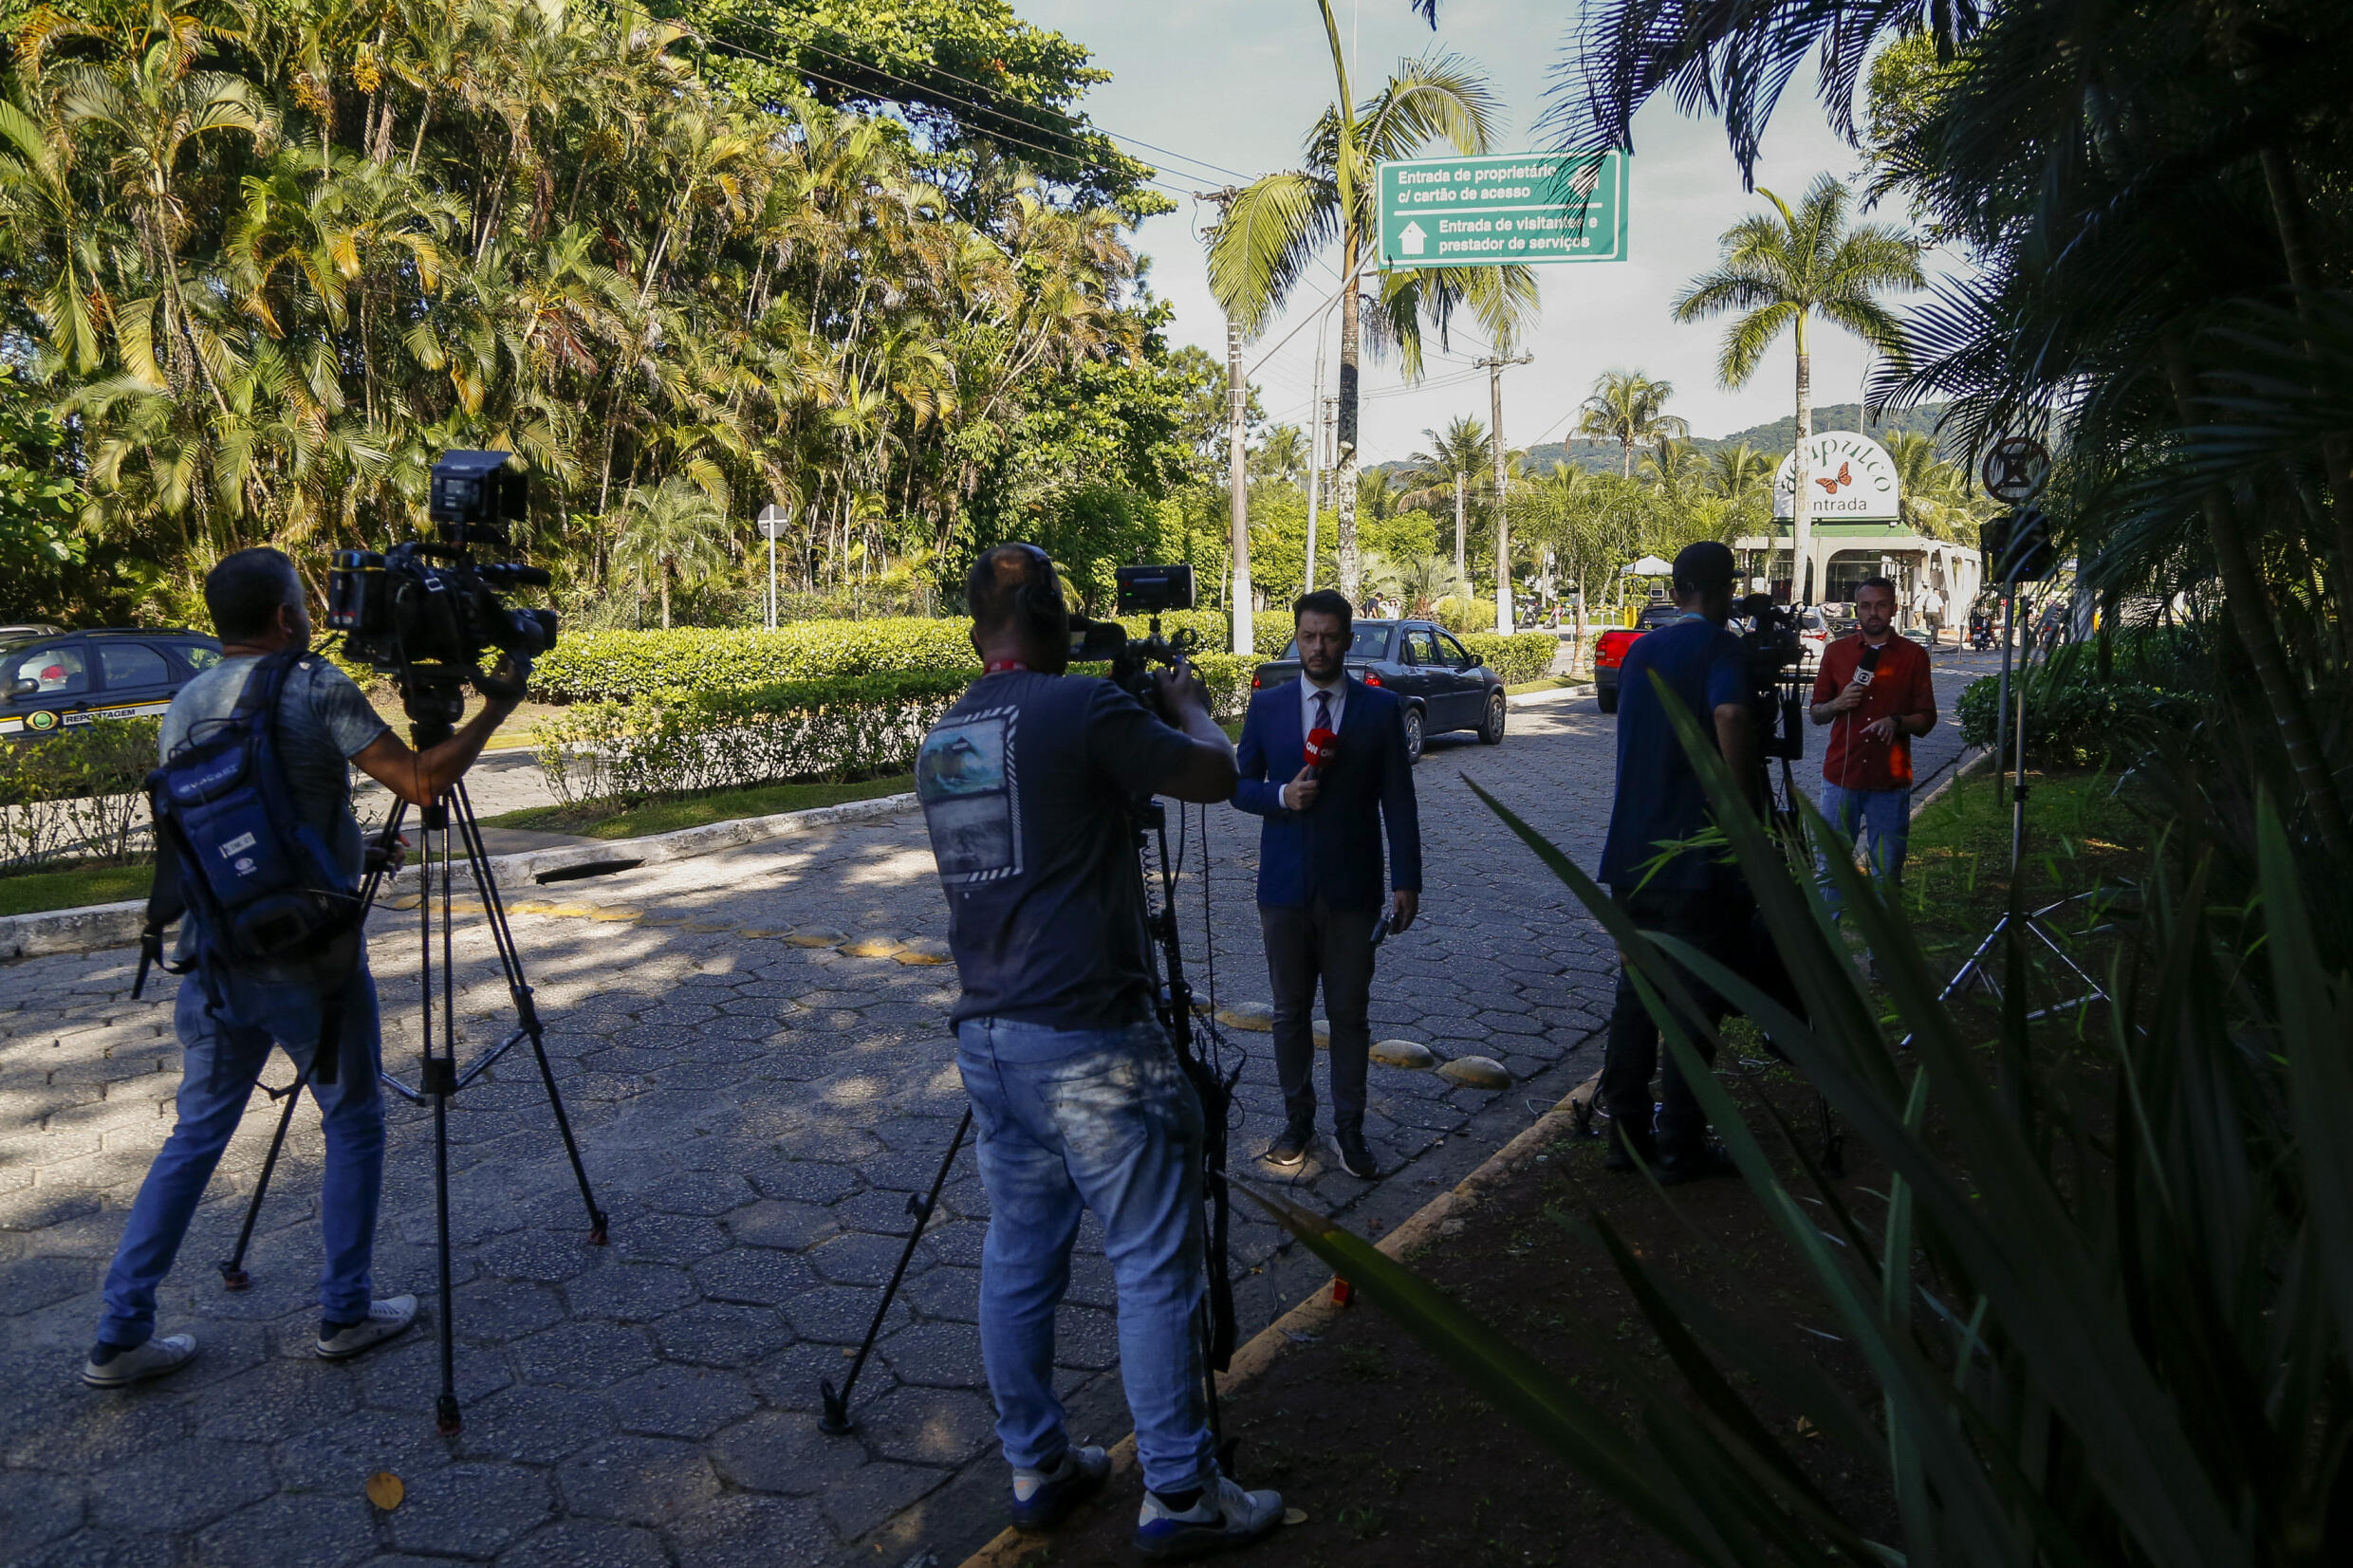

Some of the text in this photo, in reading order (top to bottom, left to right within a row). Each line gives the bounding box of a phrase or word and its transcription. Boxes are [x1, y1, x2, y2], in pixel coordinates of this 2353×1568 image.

[1398, 169, 1451, 185] Entrada
[1454, 167, 1473, 182] de
[1398, 185, 1531, 204] c/ cartão de acesso
[1438, 218, 1492, 233] Entrada
[1495, 217, 1513, 231] de
[1588, 216, 1599, 229] e
[1438, 234, 1591, 255] prestador de serviços
